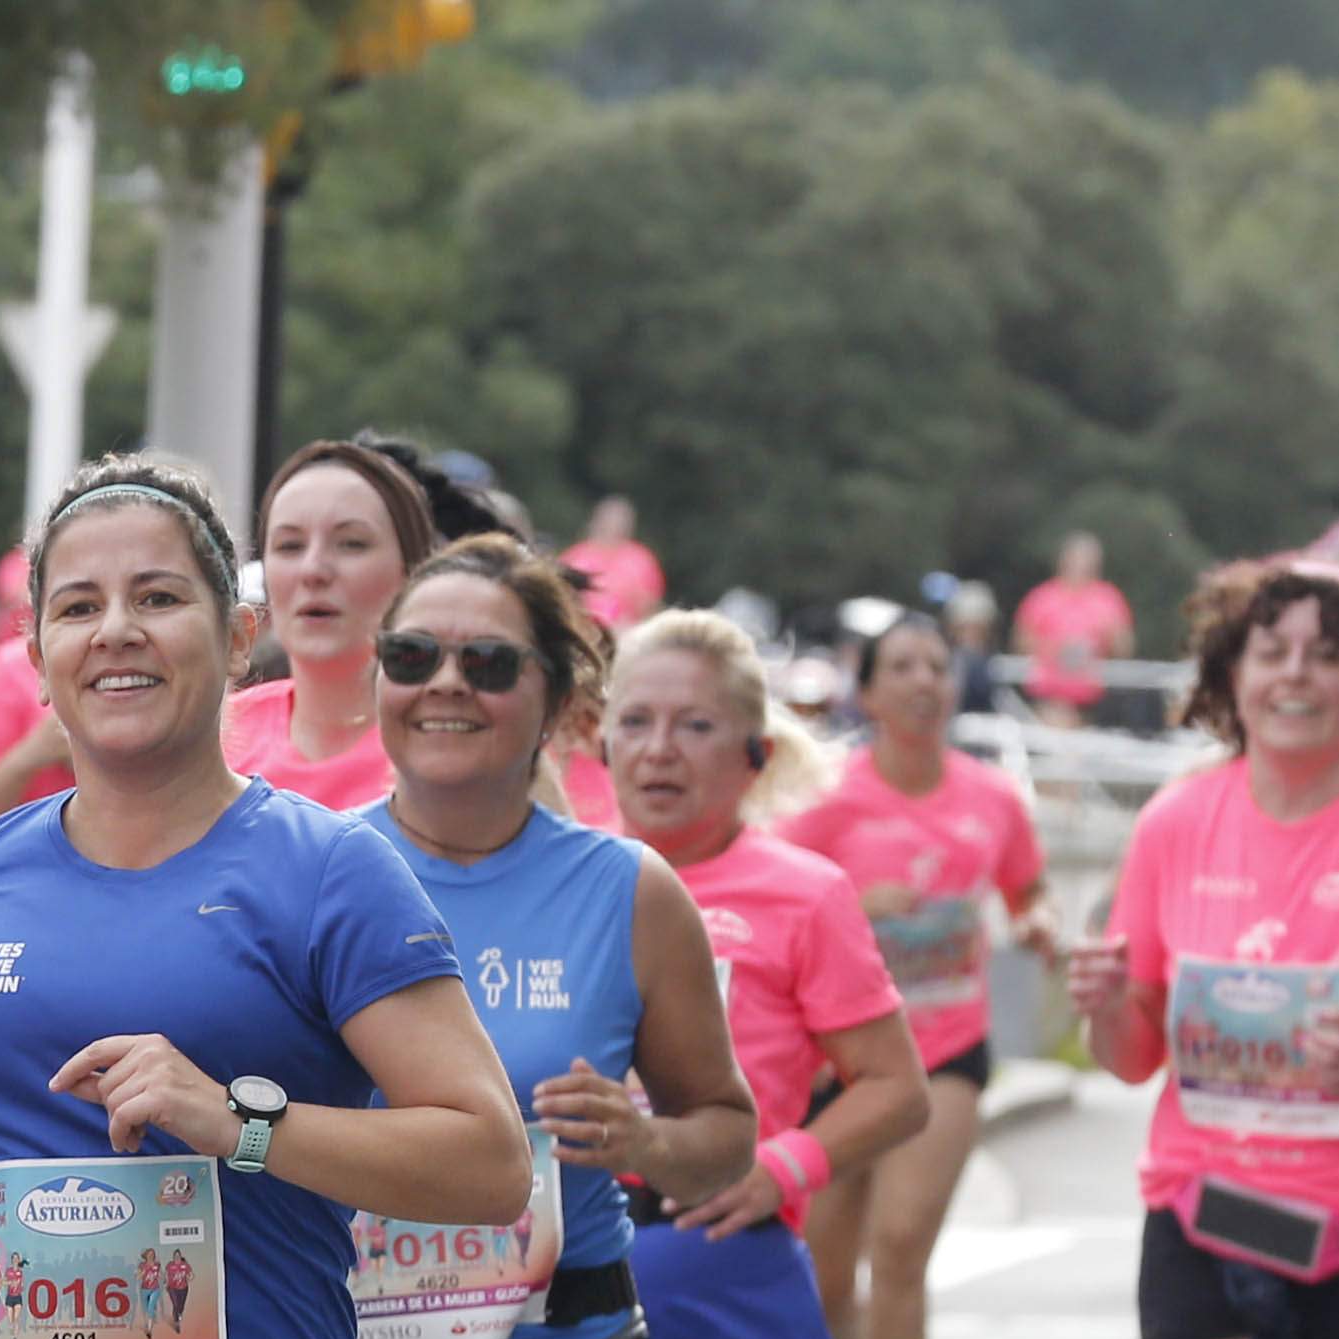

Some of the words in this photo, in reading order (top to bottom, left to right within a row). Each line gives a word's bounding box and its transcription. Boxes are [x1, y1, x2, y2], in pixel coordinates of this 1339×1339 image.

[528, 959, 564, 975] YES
[528, 976, 559, 991] WE
[528, 992, 570, 1009] RUN
[162, 1175, 188, 1194] 20
[24, 1198, 125, 1222] ASTURIANA
[393, 1228, 485, 1267] 016
[417, 1274, 459, 1290] 4620
[28, 1277, 130, 1319] 016
[408, 1298, 424, 1310] DE
[426, 1296, 443, 1308] LA
[445, 1291, 486, 1306] MUJER
[495, 1286, 530, 1301] GIJÓN
